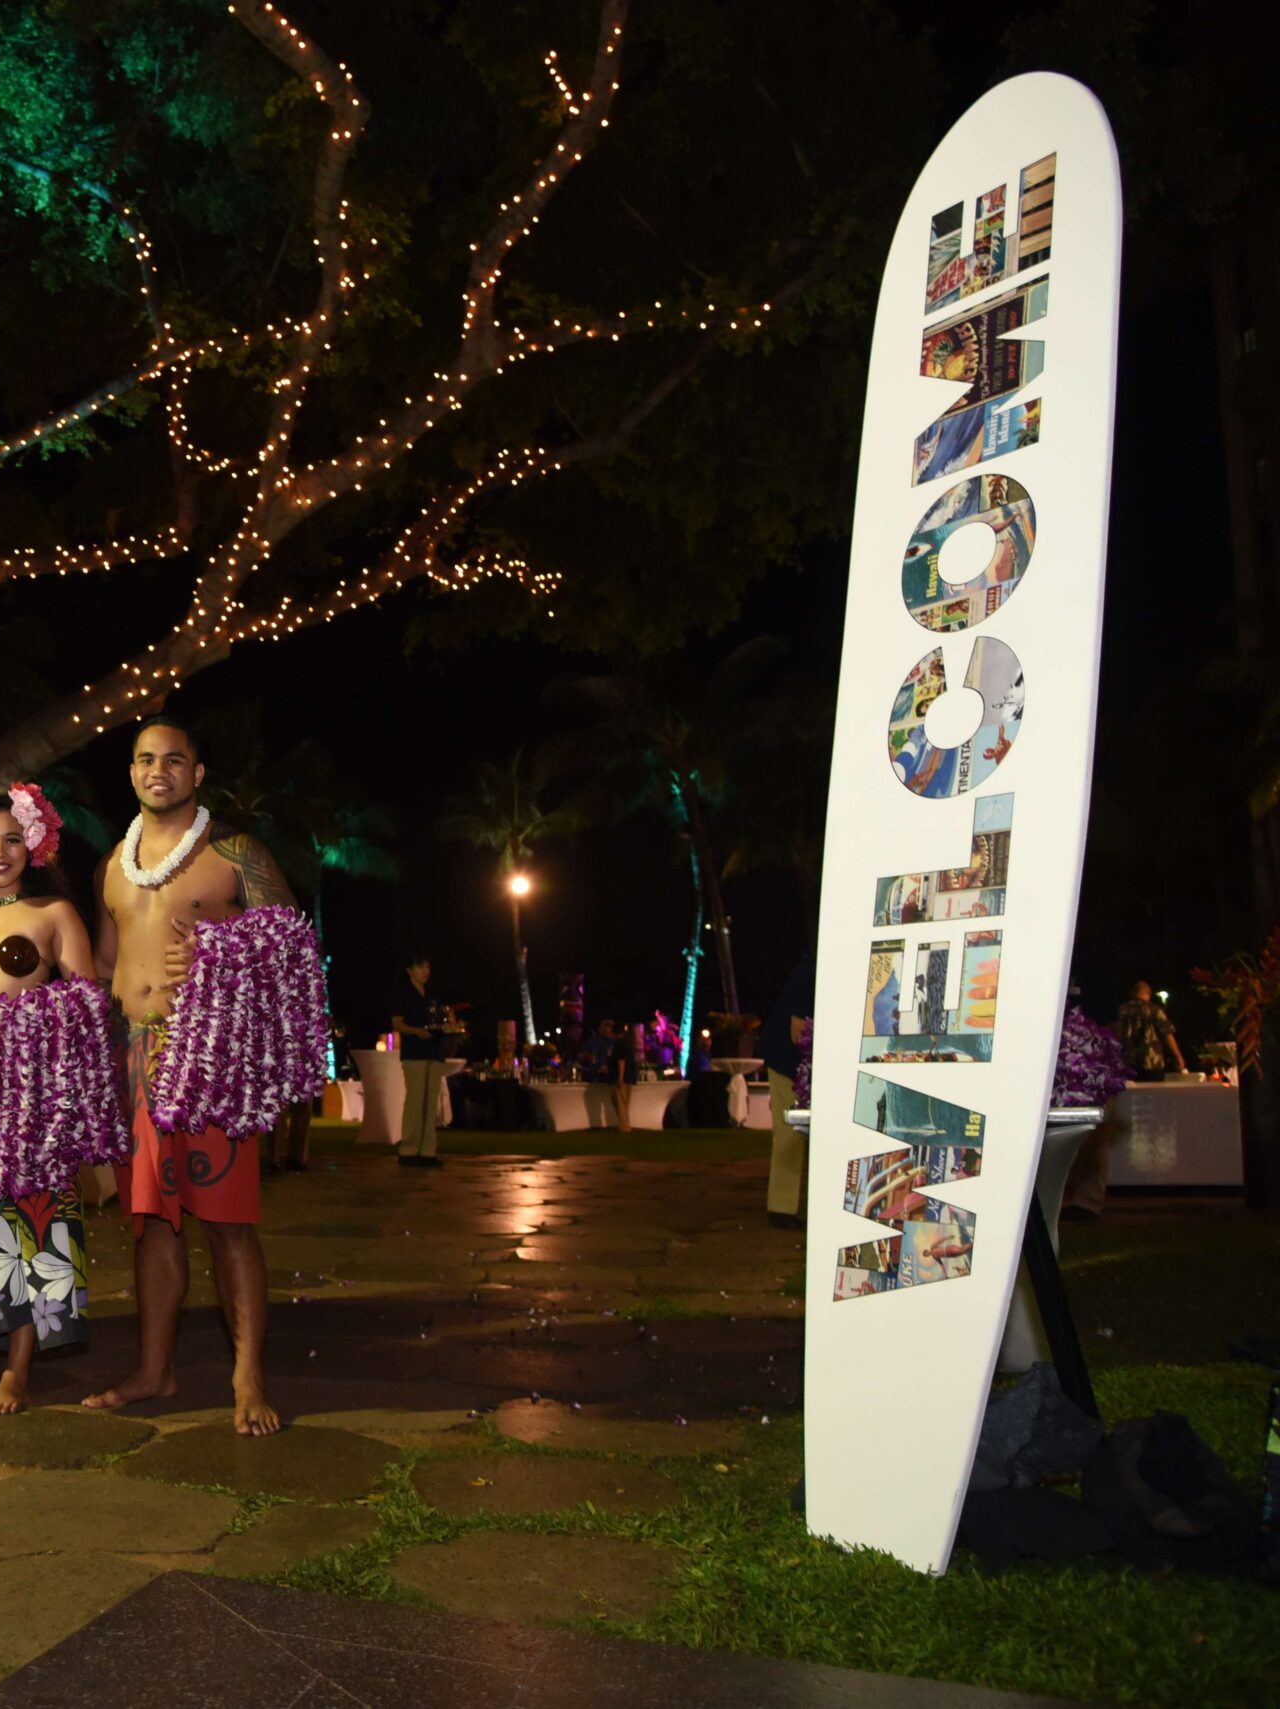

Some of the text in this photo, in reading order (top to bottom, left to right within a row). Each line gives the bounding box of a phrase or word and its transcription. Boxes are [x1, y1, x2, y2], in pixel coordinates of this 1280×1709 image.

[925, 554, 938, 598] Hawaii
[833, 151, 1057, 1302] WELCOME
[930, 1150, 946, 1184] Shore
